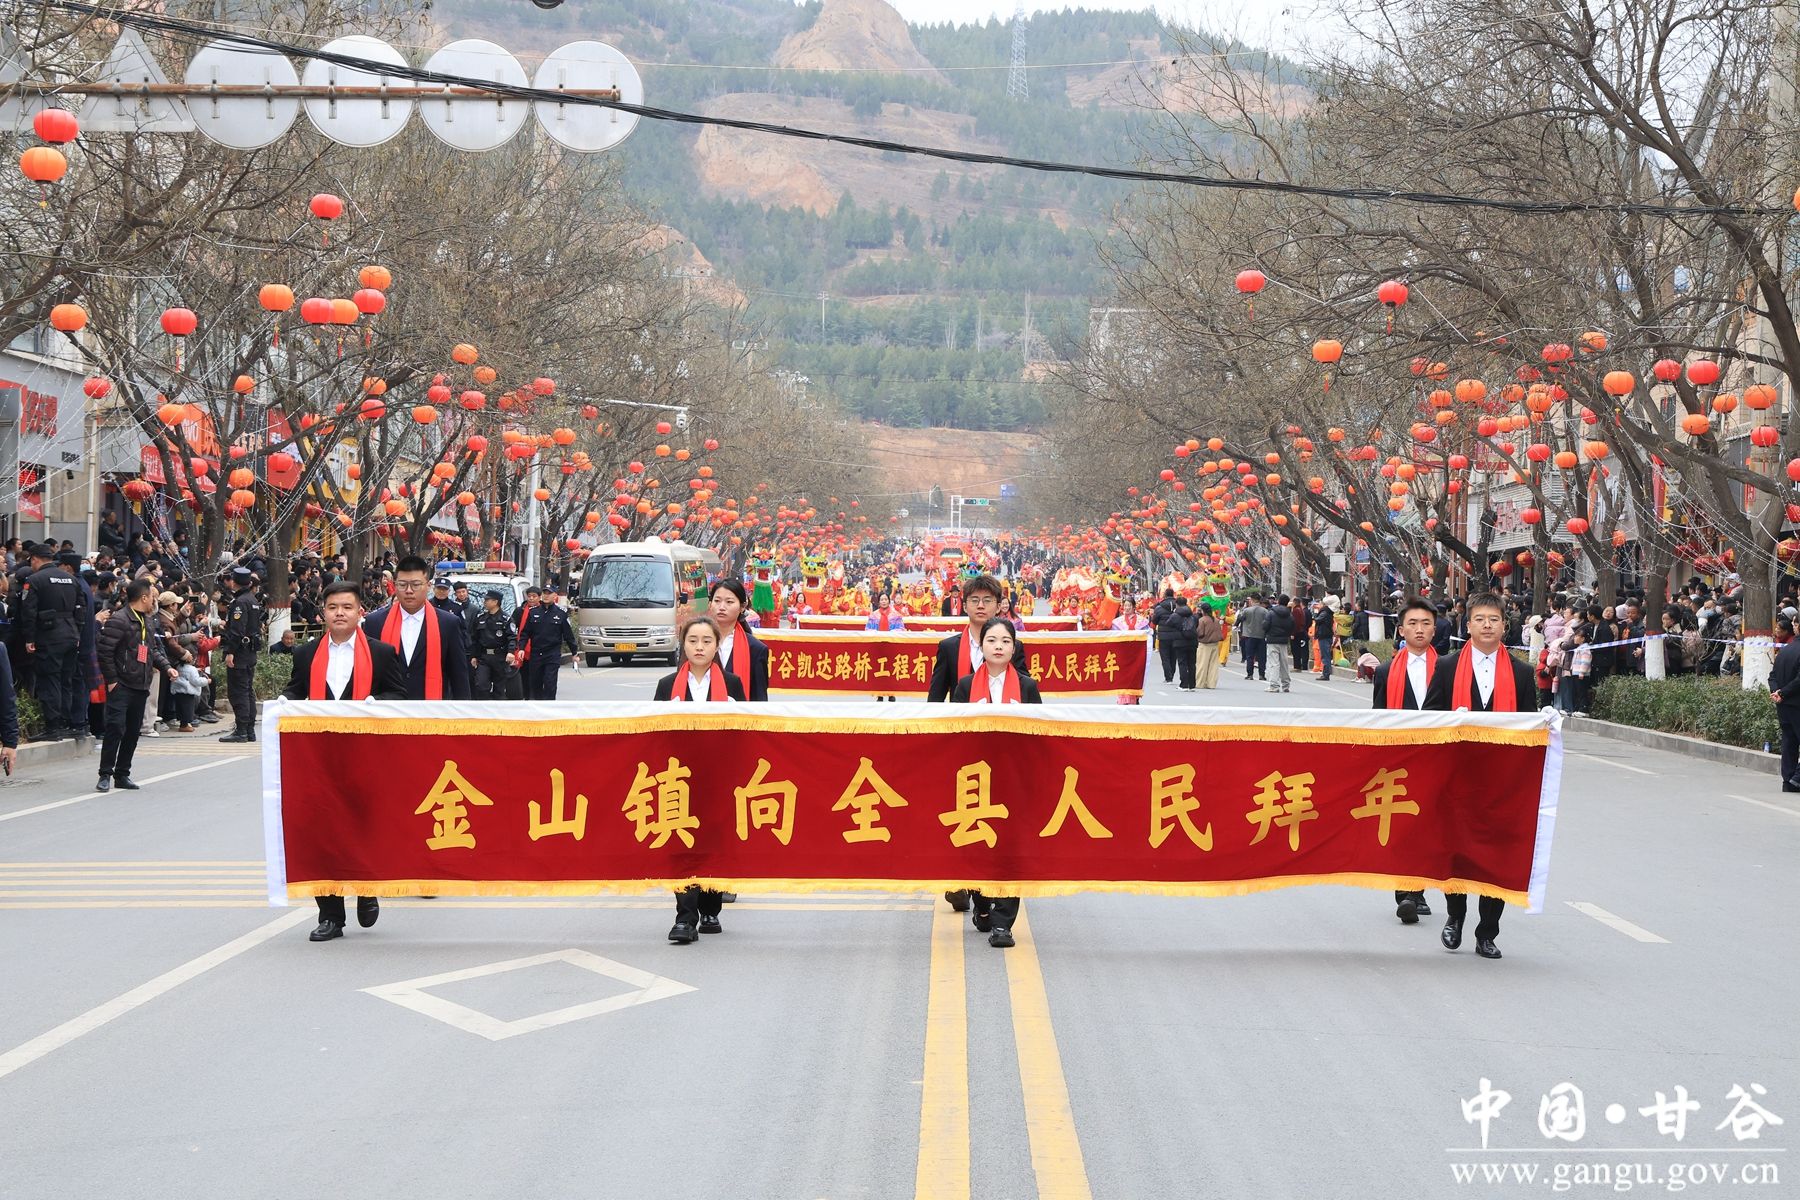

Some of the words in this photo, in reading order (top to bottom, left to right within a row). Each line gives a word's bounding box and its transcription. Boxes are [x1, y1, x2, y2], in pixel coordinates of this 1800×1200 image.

[768, 649, 937, 683] 谷凯达路桥工程有
[1028, 651, 1120, 683] 县人民拜年
[414, 757, 1421, 851] 金山镇向全县人民拜年
